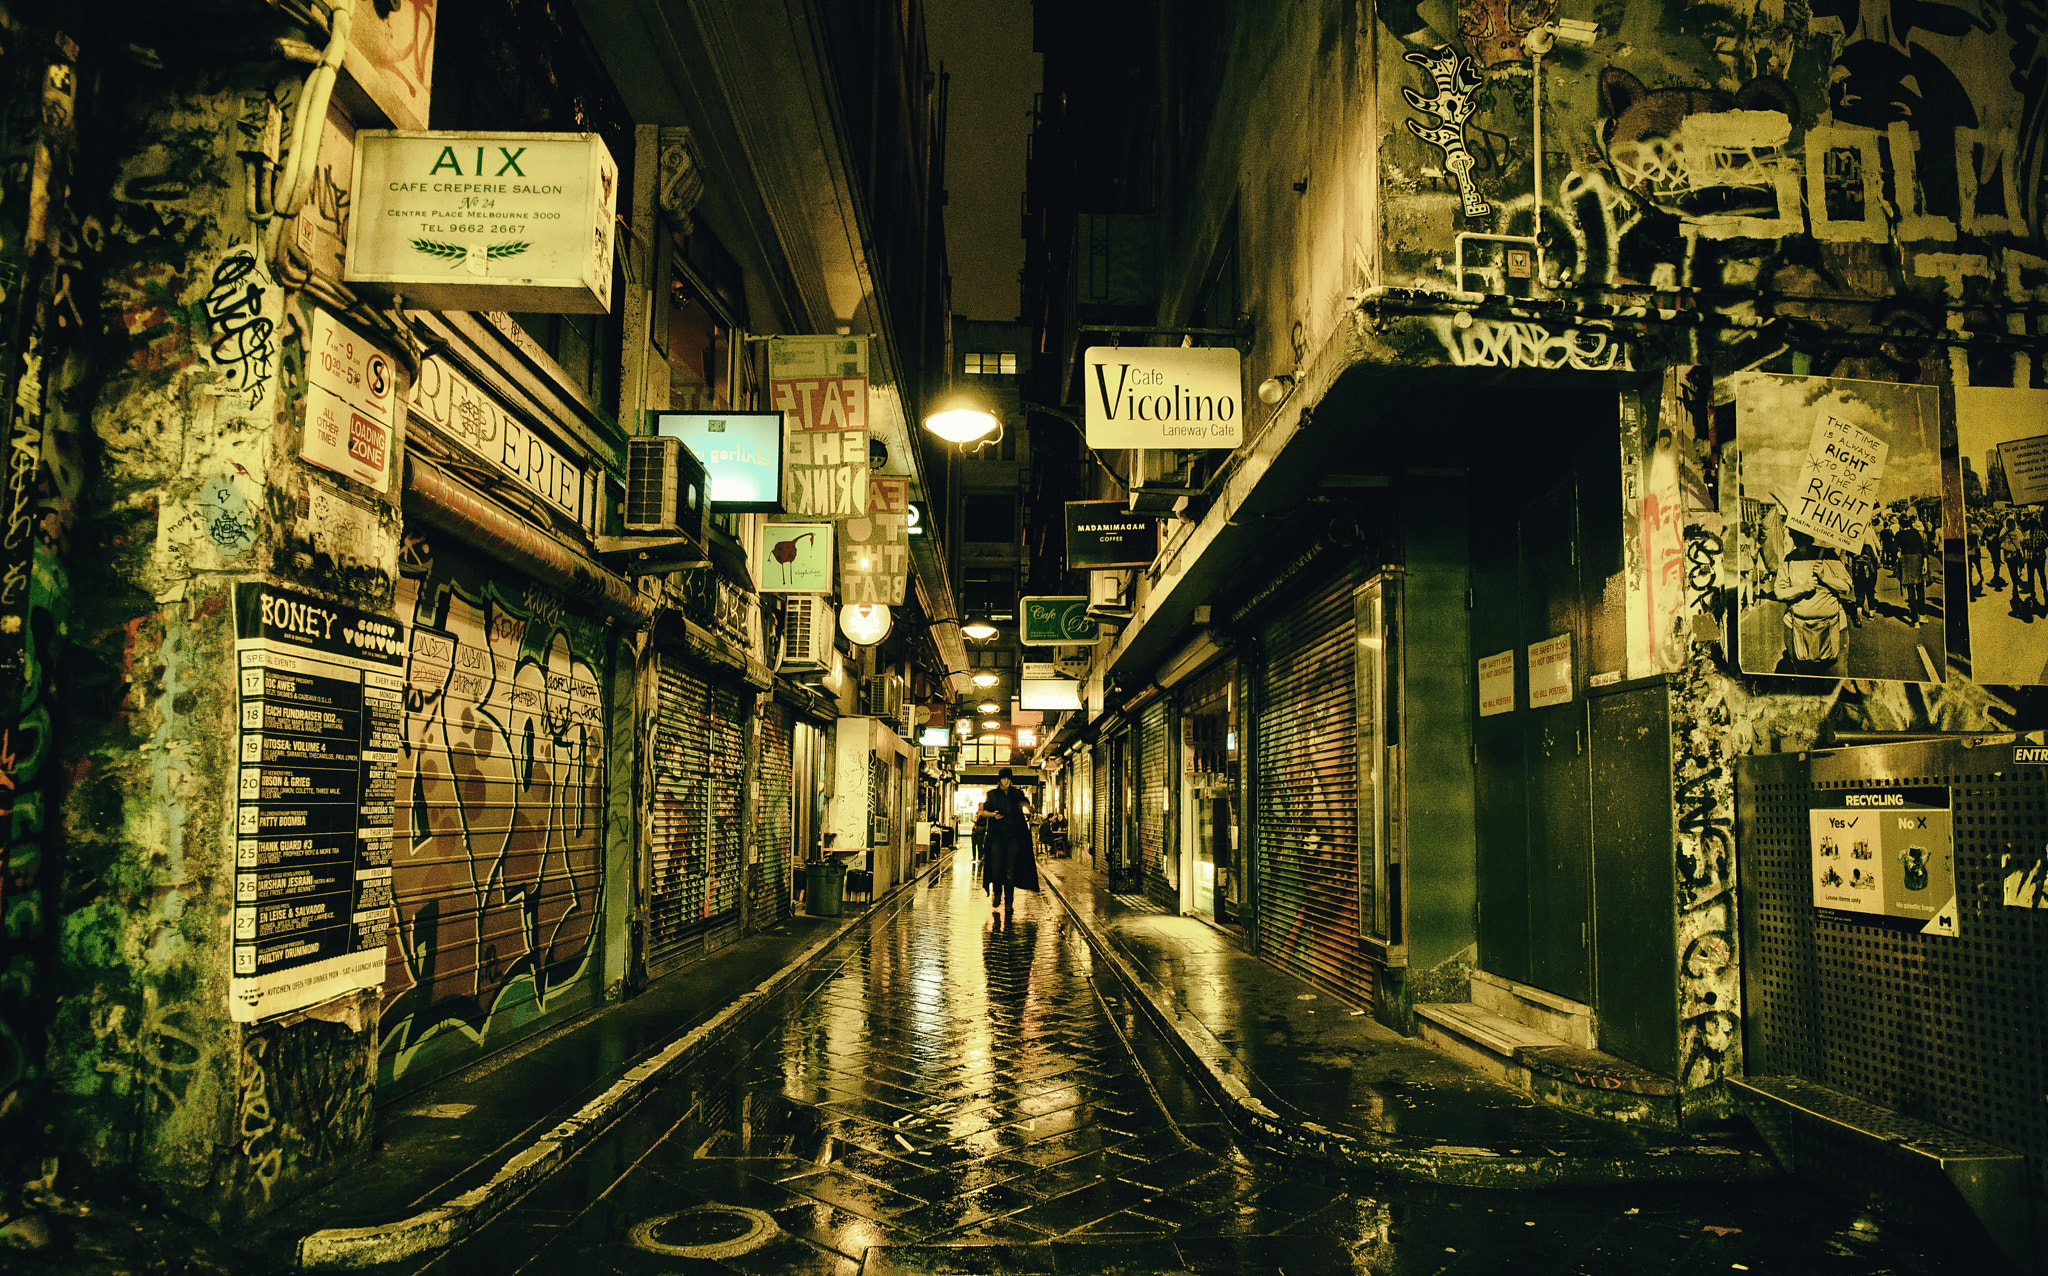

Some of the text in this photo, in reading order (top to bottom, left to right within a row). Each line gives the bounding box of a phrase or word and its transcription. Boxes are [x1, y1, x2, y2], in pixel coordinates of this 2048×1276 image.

[429, 146, 527, 177] AIX
[389, 182, 563, 194] CAFE CREPERIE SALON
[482, 199, 495, 208] 24
[449, 224, 484, 233] 9662
[490, 224, 526, 234] 2667
[1131, 368, 1164, 385] Cafe
[1092, 364, 1234, 421] Vicolino
[323, 408, 335, 422] ALL
[316, 417, 338, 436] OTHER
[1162, 424, 1235, 438] Laneway Cafe
[318, 429, 337, 447] TIMES
[350, 418, 386, 451] LOADING
[1828, 416, 1880, 452] THE TIME
[352, 437, 382, 466] ZONE
[1824, 430, 1877, 464] IS ALWAYS
[1825, 444, 1869, 472] RIGHT
[2016, 450, 2042, 458] children,
[1825, 460, 1856, 481] TO DO
[1831, 474, 1850, 489] THE
[1808, 478, 1869, 515] RIGHT
[1791, 516, 1851, 546] MARTIN LUTHER KING
[260, 594, 338, 640] BONEY
[1030, 605, 1056, 623] Cafe
[1530, 640, 1567, 658] FIRE SAFETY DOOR
[274, 656, 297, 669] EVENTS
[1489, 660, 1500, 668] SAFETY
[1501, 656, 1512, 665] DOOR
[1537, 657, 1545, 666] NOT
[1546, 652, 1567, 664] OBSTRUCT
[1494, 666, 1512, 676] OBSTRUCT
[246, 678, 260, 688] 17
[376, 676, 388, 685] EVERY
[380, 690, 397, 700] MONDAY
[1533, 685, 1568, 699] NO BILL POSTERS
[1496, 696, 1511, 705] POSTERS
[246, 710, 258, 719] 18
[283, 708, 322, 721] FUNDRAISER
[323, 712, 336, 722] 002
[246, 743, 258, 753] 19
[293, 740, 326, 753] VOLUME 4
[242, 779, 258, 788] 20
[284, 777, 310, 787] & GRIEG
[1846, 794, 1904, 806] RECYCLING
[241, 815, 256, 826] 24
[259, 816, 306, 827] PATTY BOOMBA
[1829, 818, 1915, 830] Yes No
[258, 839, 312, 852] THANK GUARD #3
[240, 848, 255, 858] 25
[239, 882, 255, 892] 26
[288, 875, 313, 887] JESRANI
[269, 903, 325, 921] LEISE & SALVADOR
[1922, 904, 1935, 912] bags
[237, 918, 254, 929] 27
[359, 926, 370, 936] LOST
[285, 943, 319, 959] DRUMMOND
[238, 955, 252, 966] 31
[268, 985, 291, 996] KITCHEN
[292, 982, 304, 991] OPEN
[313, 975, 328, 985] DINNER
[329, 972, 339, 980] MON
[355, 963, 372, 973] LUNCH
